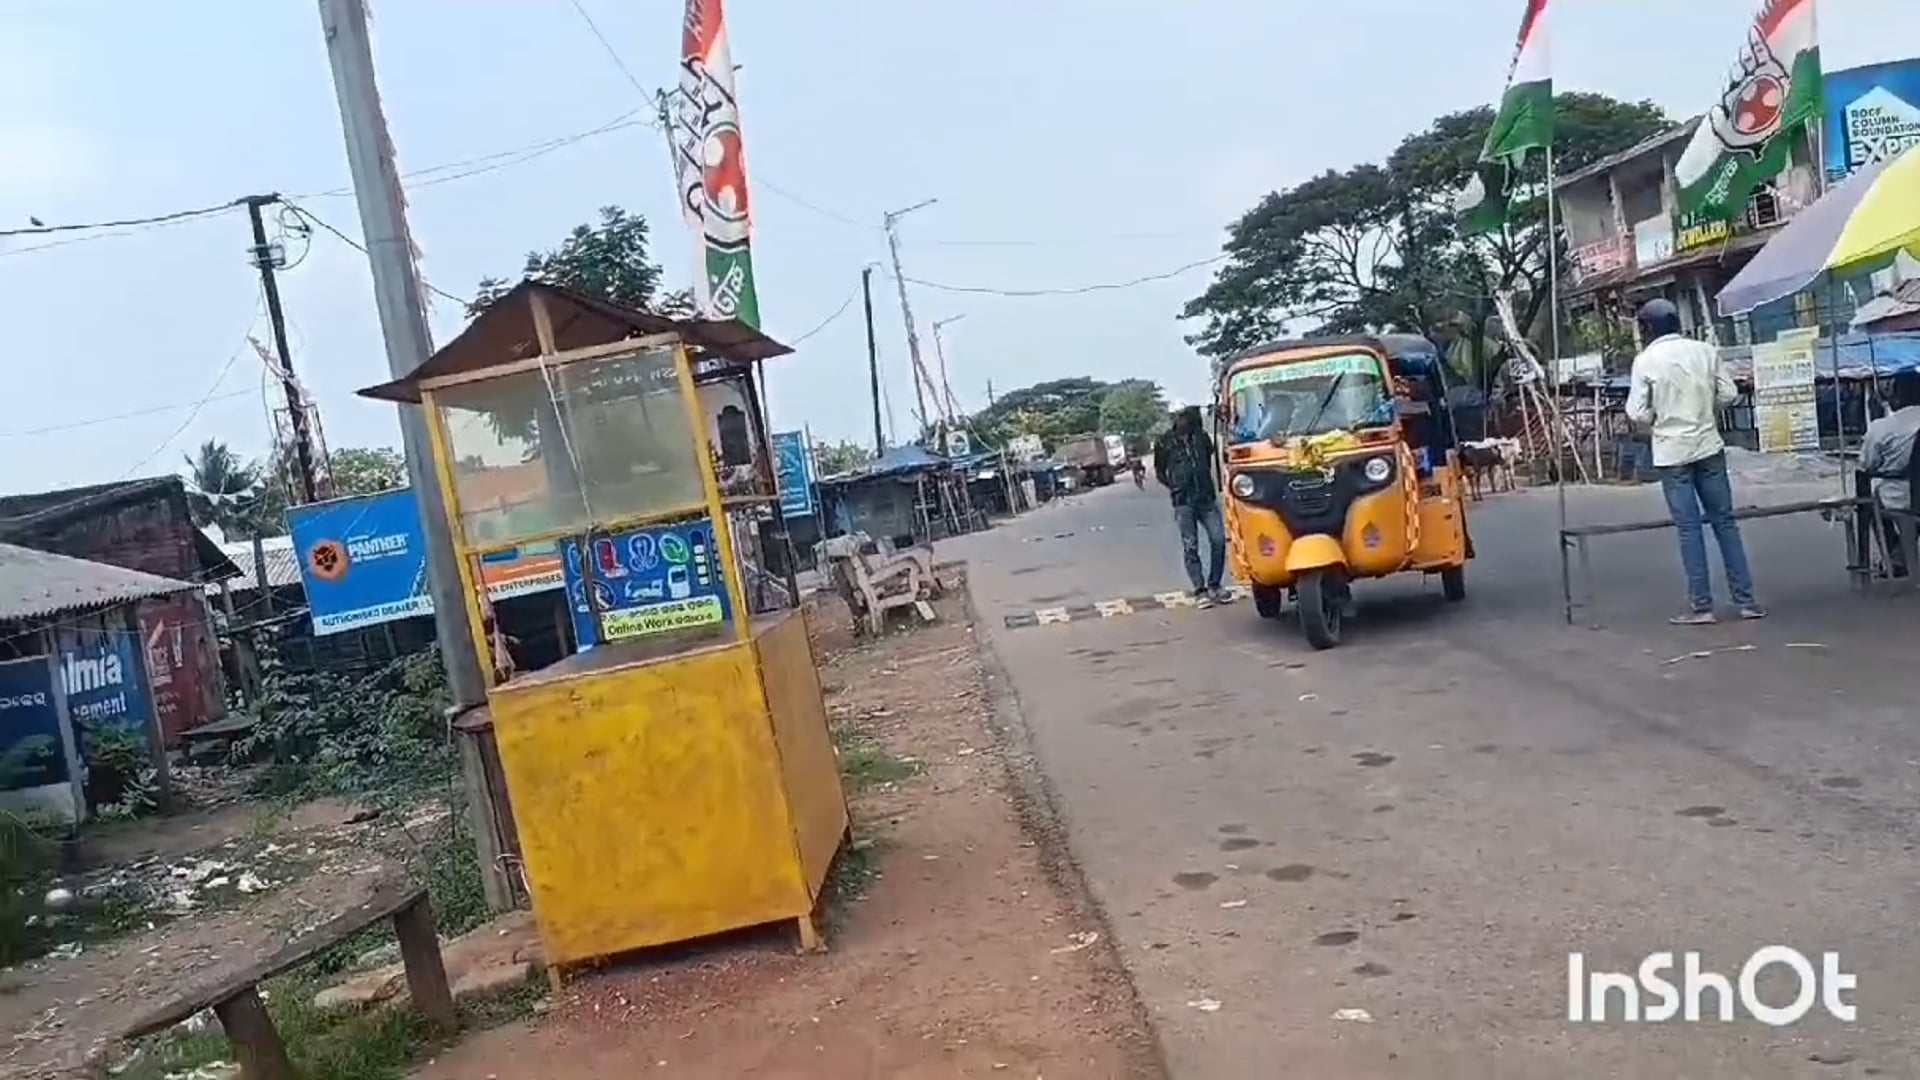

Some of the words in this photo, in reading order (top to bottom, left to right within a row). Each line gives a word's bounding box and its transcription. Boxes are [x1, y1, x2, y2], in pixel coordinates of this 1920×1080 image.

[1851, 115, 1899, 128] COLUMN
[347, 533, 408, 557] PANTHER
[607, 622, 643, 635] Online
[644, 617, 673, 629] Work
